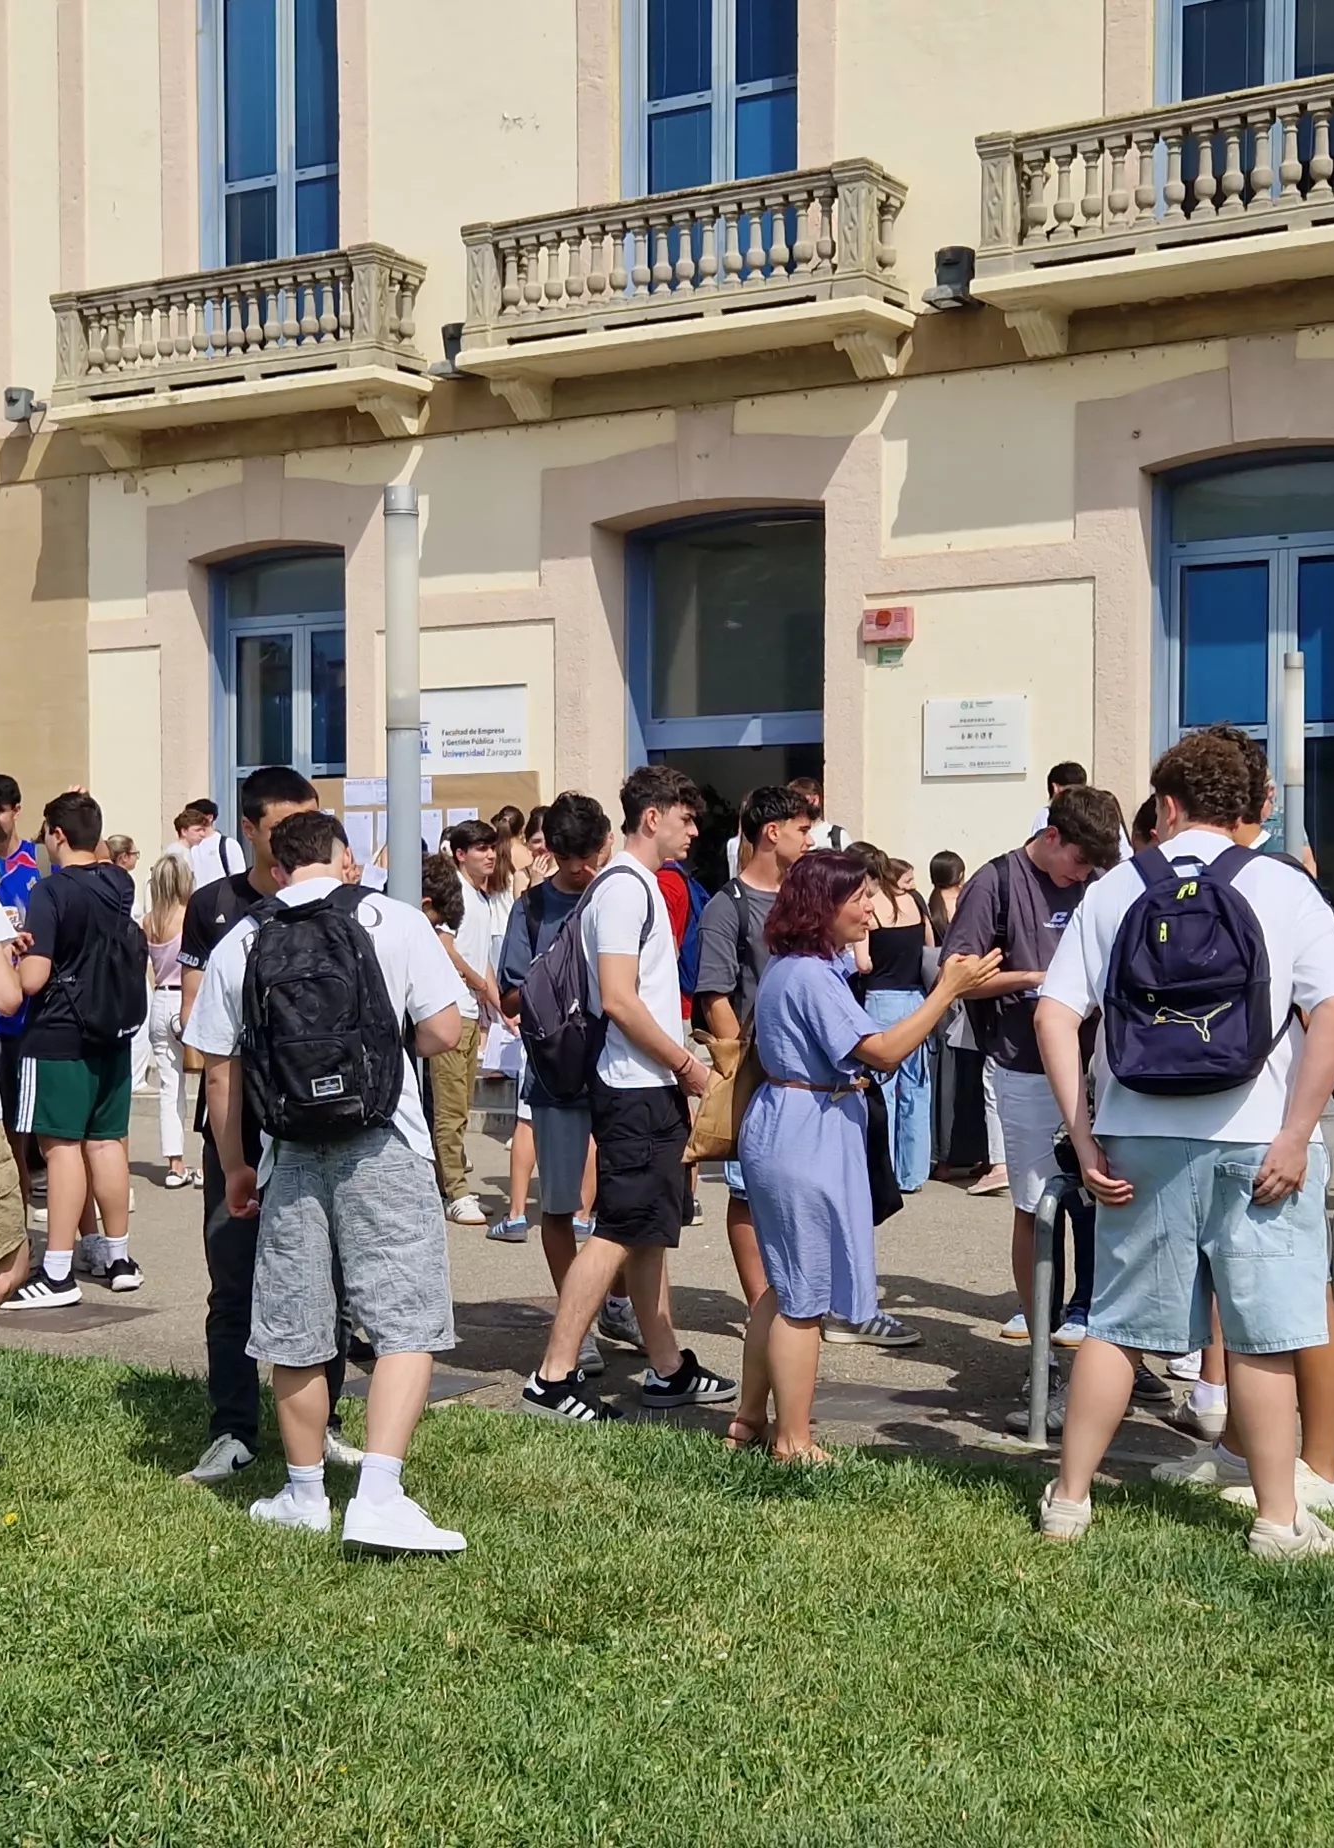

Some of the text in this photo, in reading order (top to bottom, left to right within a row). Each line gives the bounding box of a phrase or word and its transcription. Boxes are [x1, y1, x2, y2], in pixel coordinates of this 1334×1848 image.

[478, 727, 505, 735] Empresa
[442, 747, 522, 758] Universidad Zaragoza
